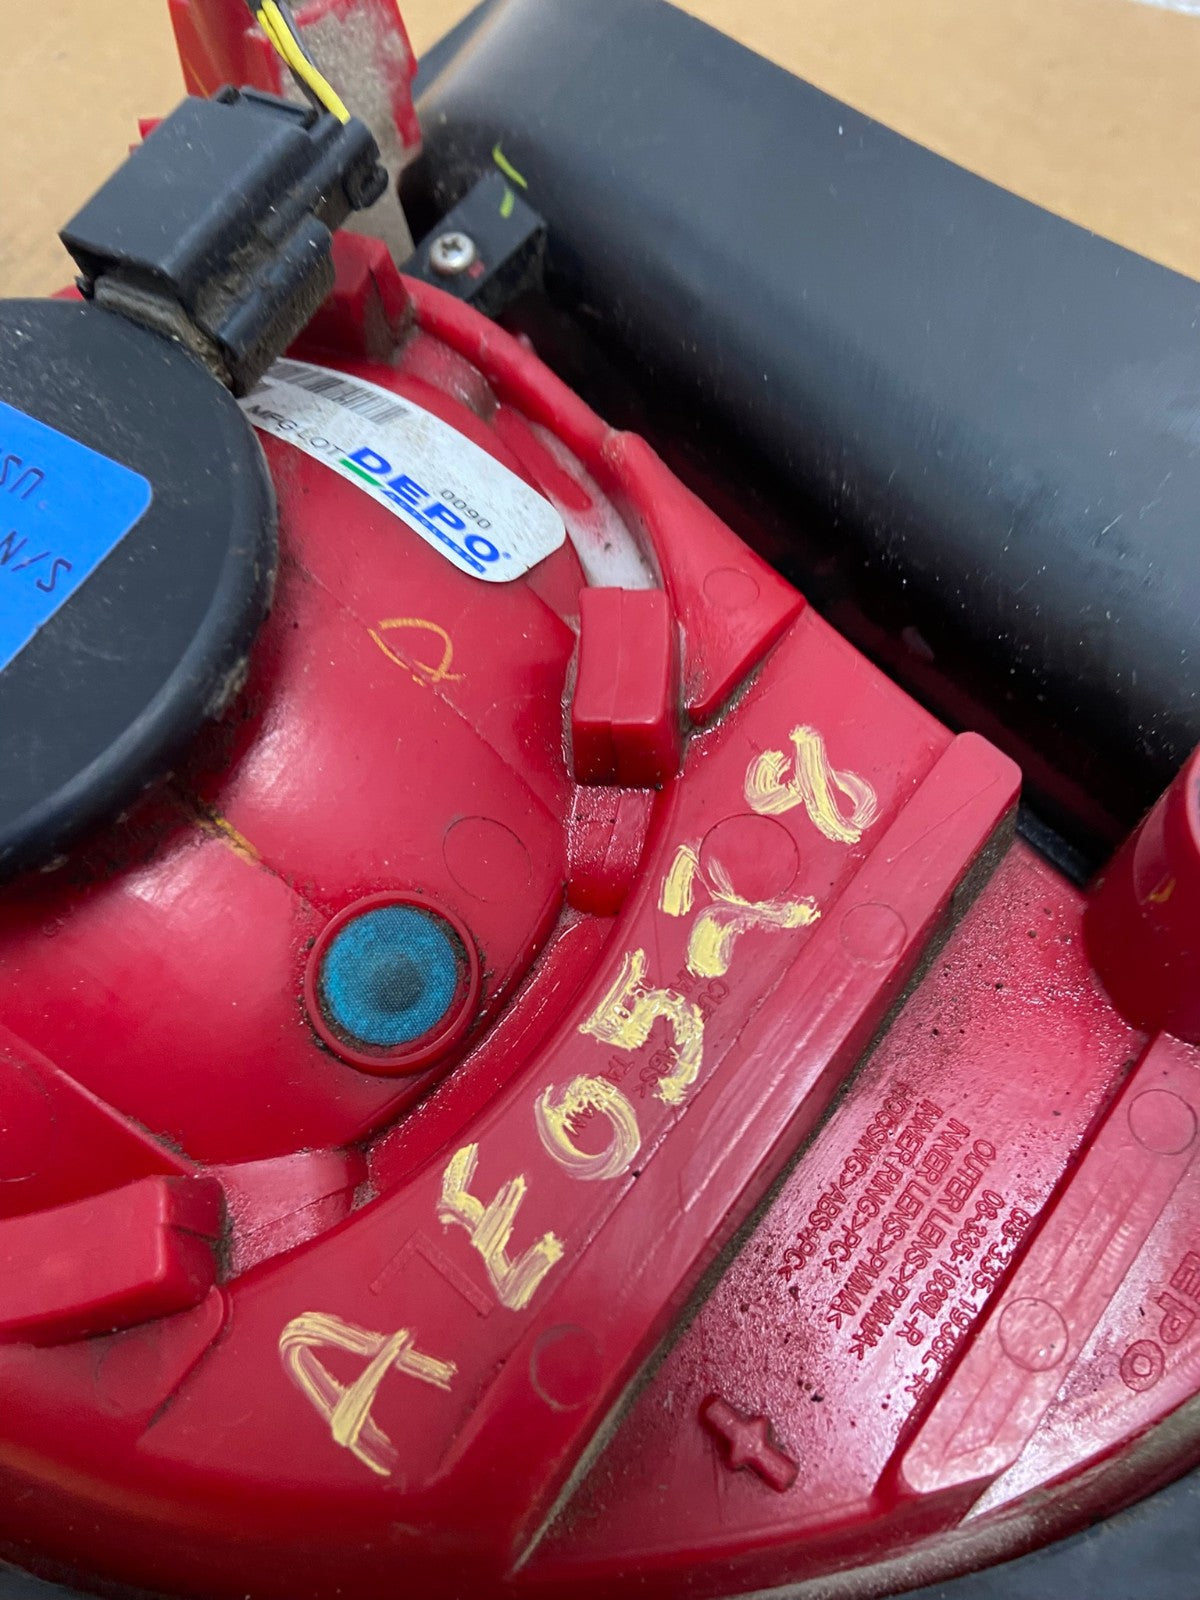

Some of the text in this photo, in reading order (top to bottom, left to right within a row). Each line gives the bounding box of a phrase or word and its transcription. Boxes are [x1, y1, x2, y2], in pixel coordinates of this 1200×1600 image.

[347, 446, 502, 563] DEPO
[890, 1099, 944, 1165] INNER
[915, 1117, 971, 1185] INNER
[938, 1138, 997, 1213] OUTER
[896, 1188, 1005, 1347] 08-335-1939L-R
